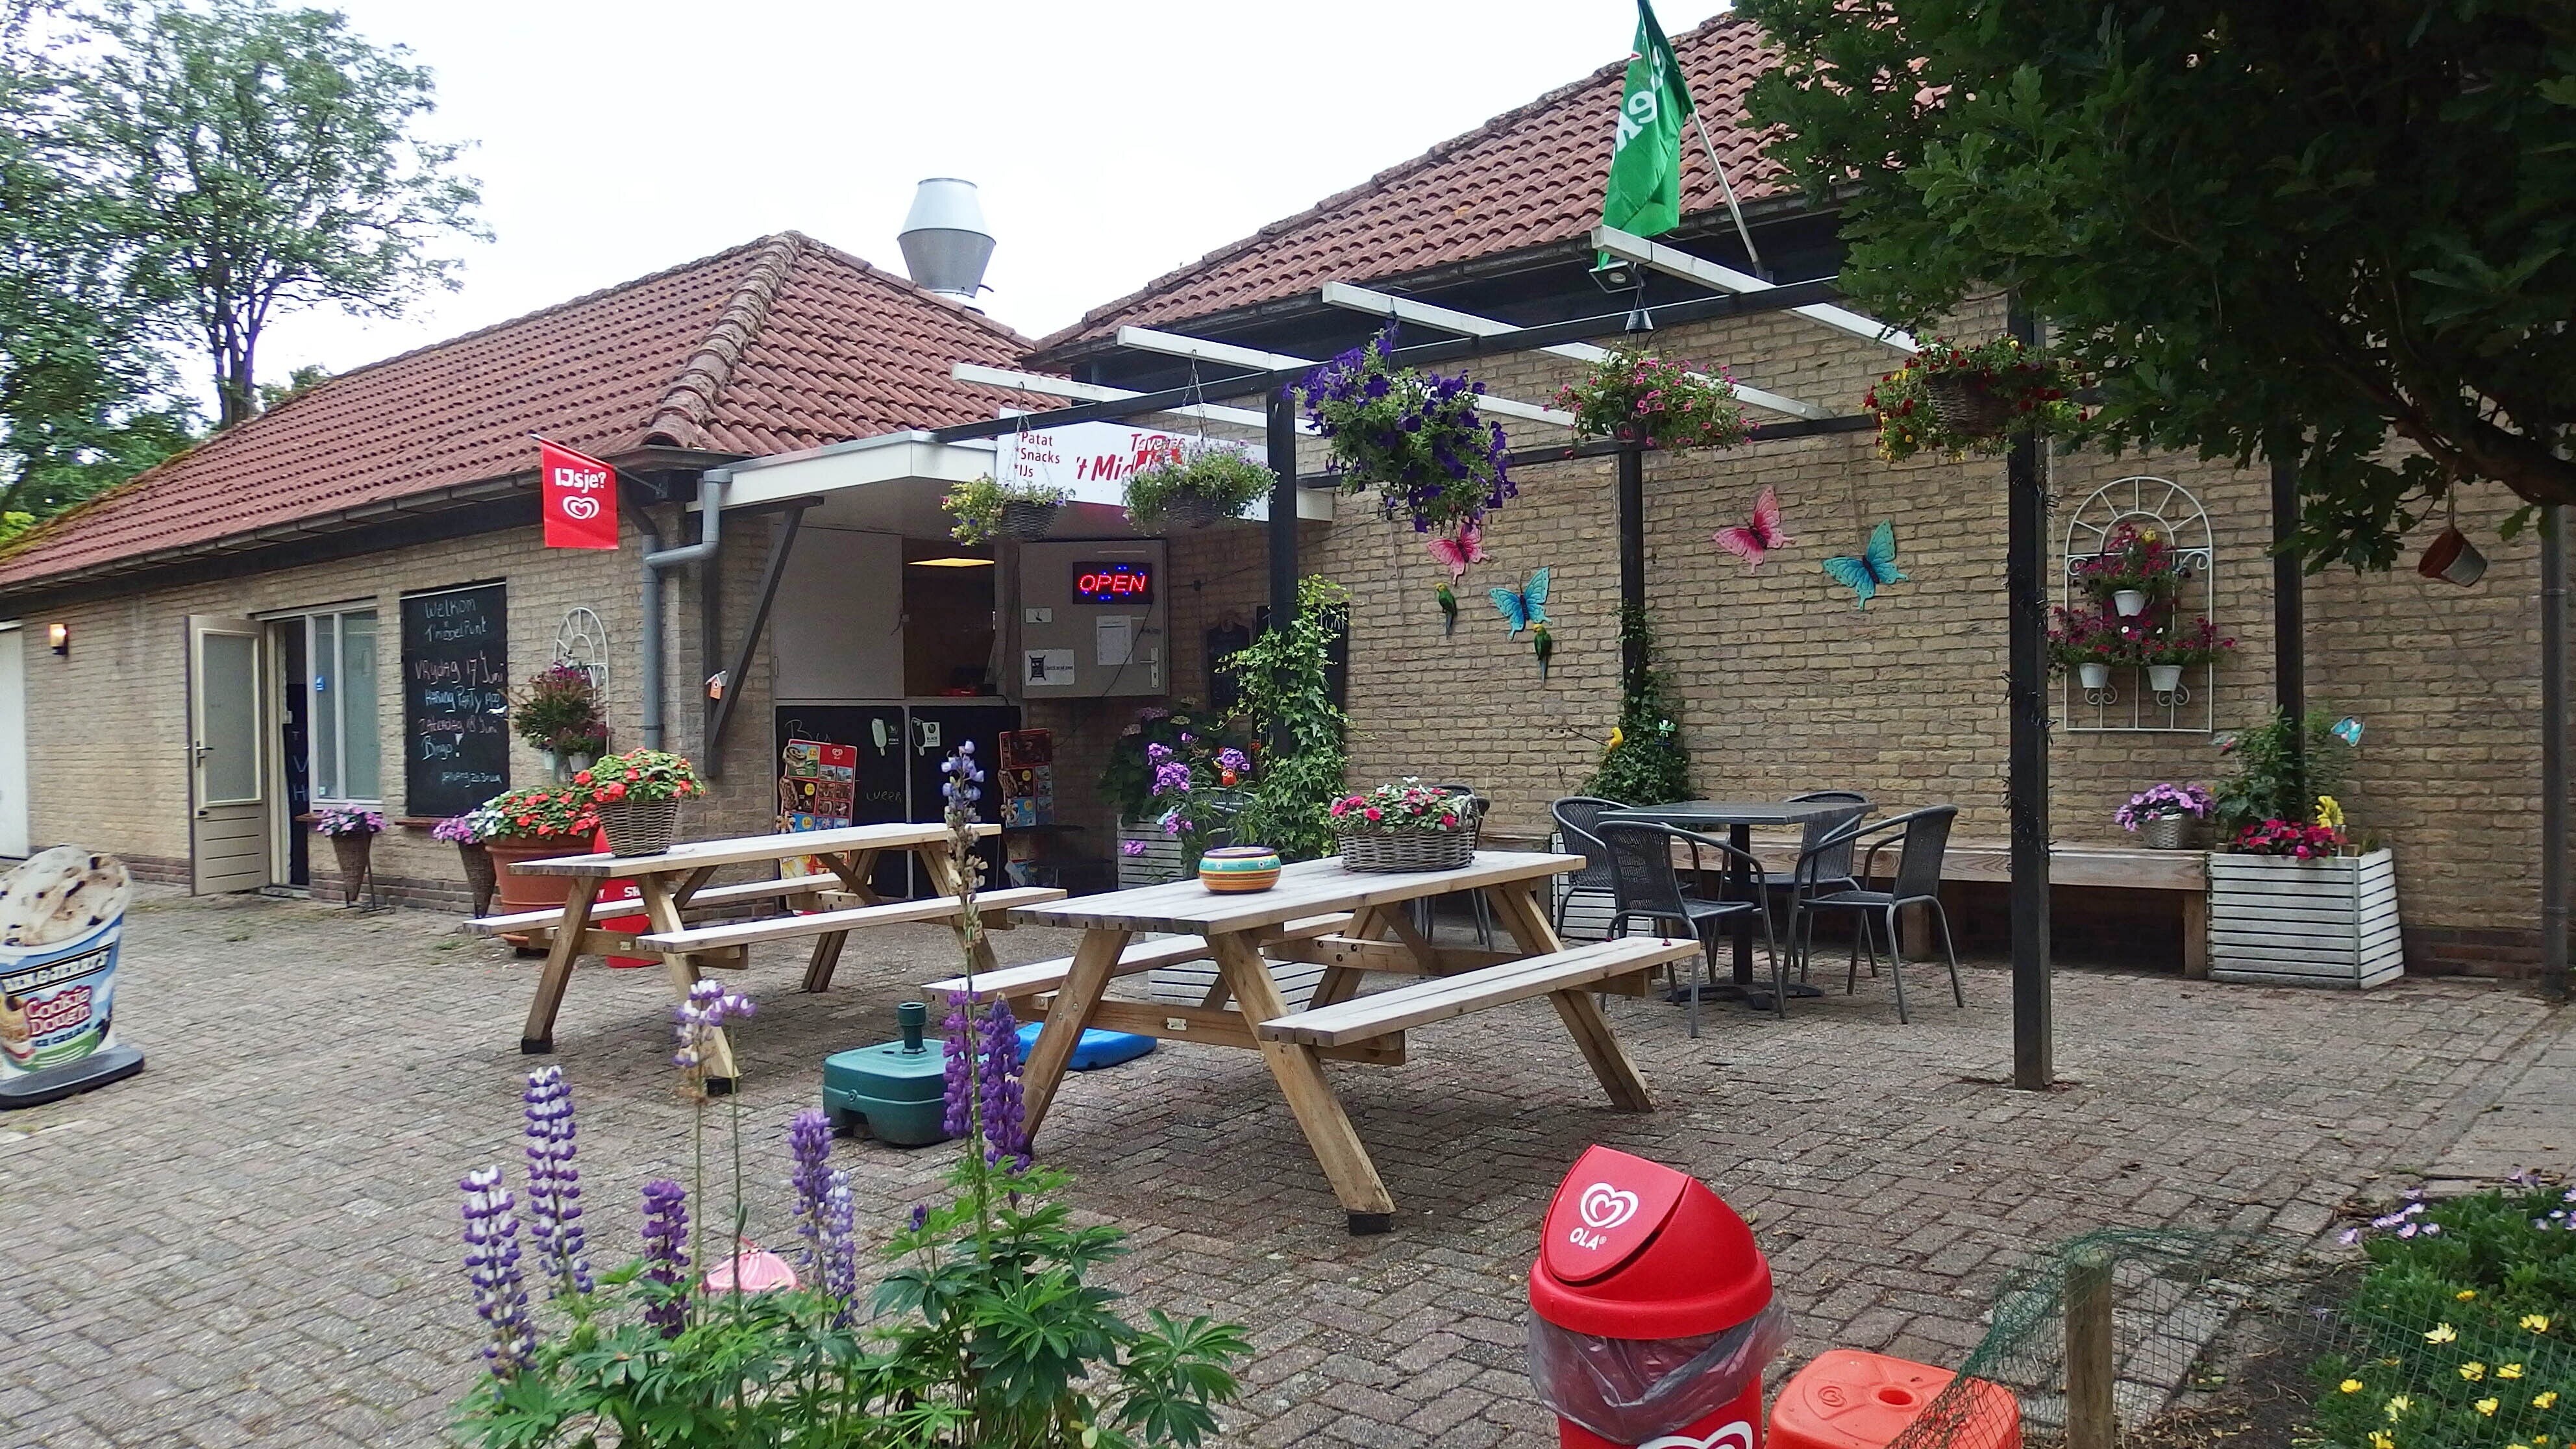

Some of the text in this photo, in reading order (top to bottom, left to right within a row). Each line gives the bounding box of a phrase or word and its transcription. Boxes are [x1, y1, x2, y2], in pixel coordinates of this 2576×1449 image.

[1021, 430, 1053, 447] Patat
[1020, 447, 1060, 464] Snacks
[1019, 464, 1034, 477] IJs
[554, 467, 607, 493] IJsje?
[1080, 575, 1146, 591] OPEN
[26, 987, 92, 1018] Cookie
[29, 1005, 92, 1035] Dough
